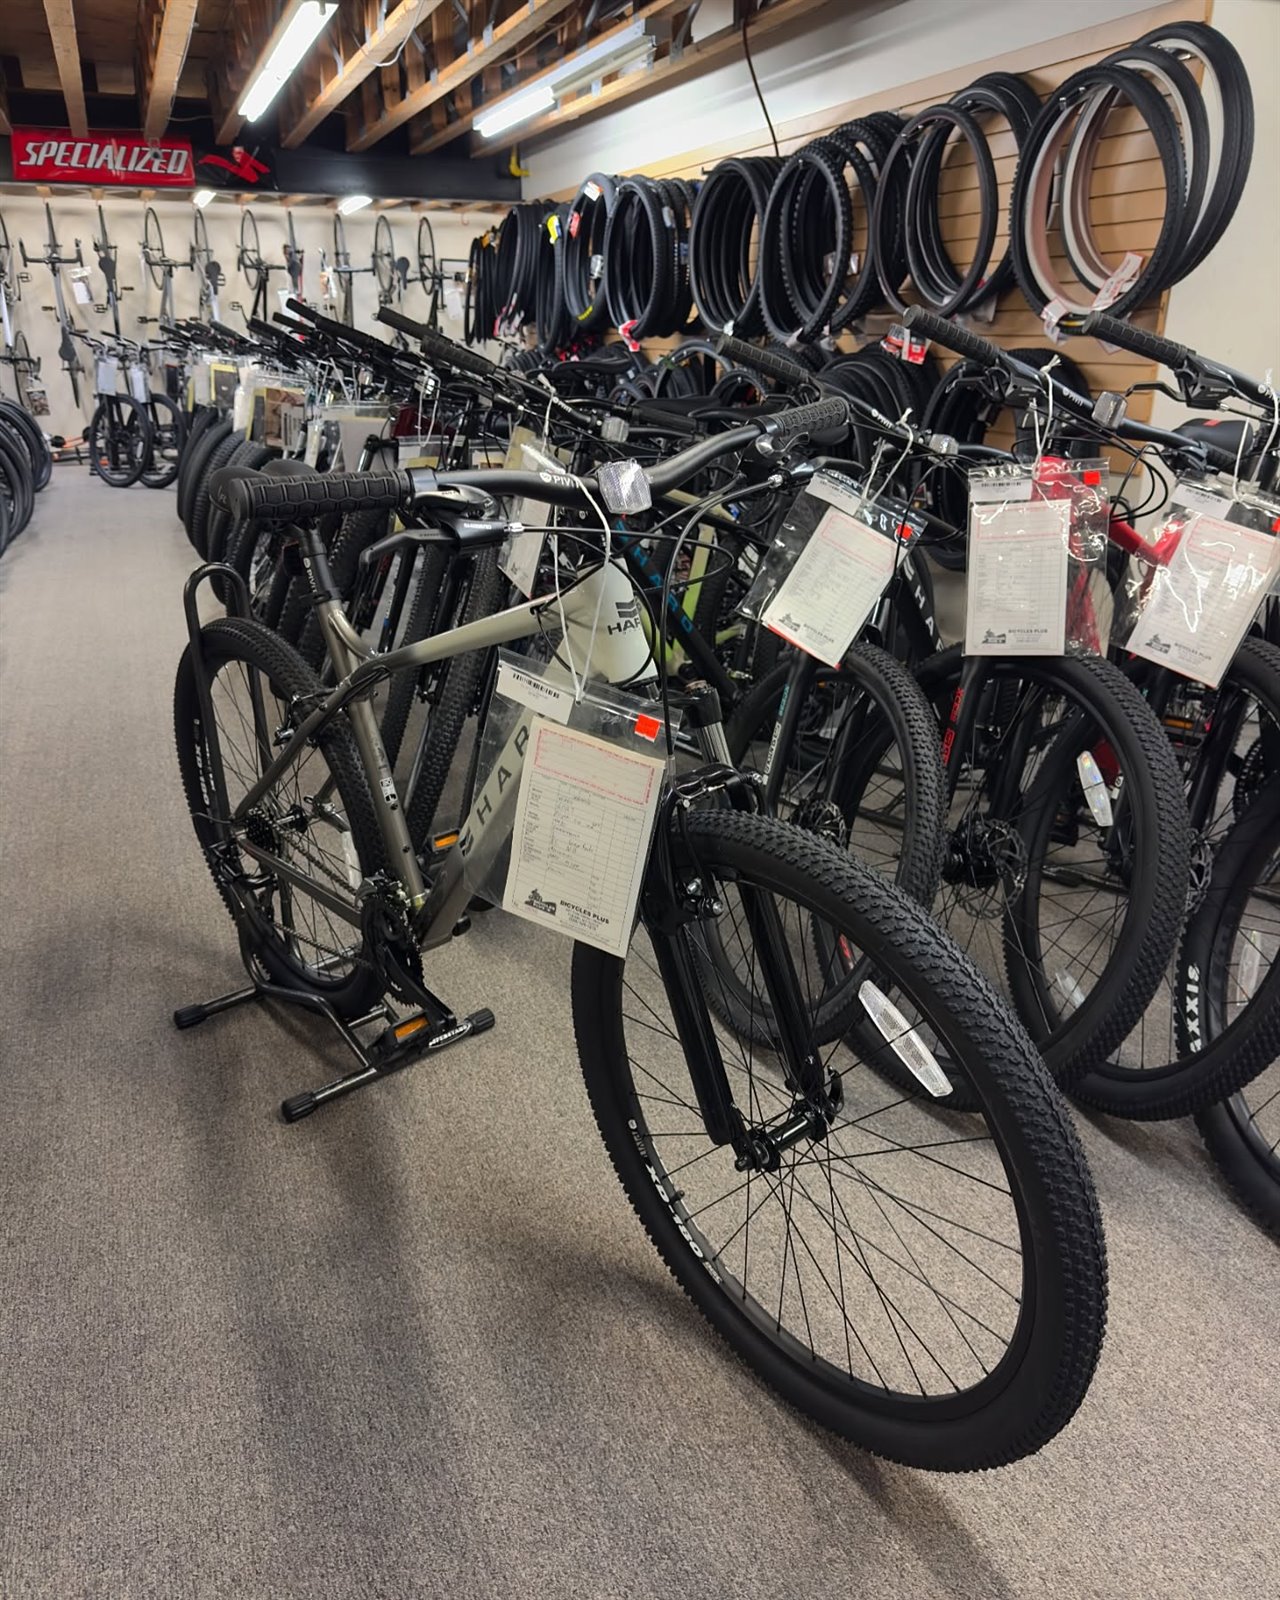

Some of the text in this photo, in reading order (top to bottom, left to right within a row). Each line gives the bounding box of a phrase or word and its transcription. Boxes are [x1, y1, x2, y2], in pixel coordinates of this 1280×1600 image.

[20, 141, 188, 175] SPECIALIZED
[560, 900, 592, 917] BICYCLES
[592, 912, 610, 924] PLUS
[645, 1162, 704, 1258] XD-180
